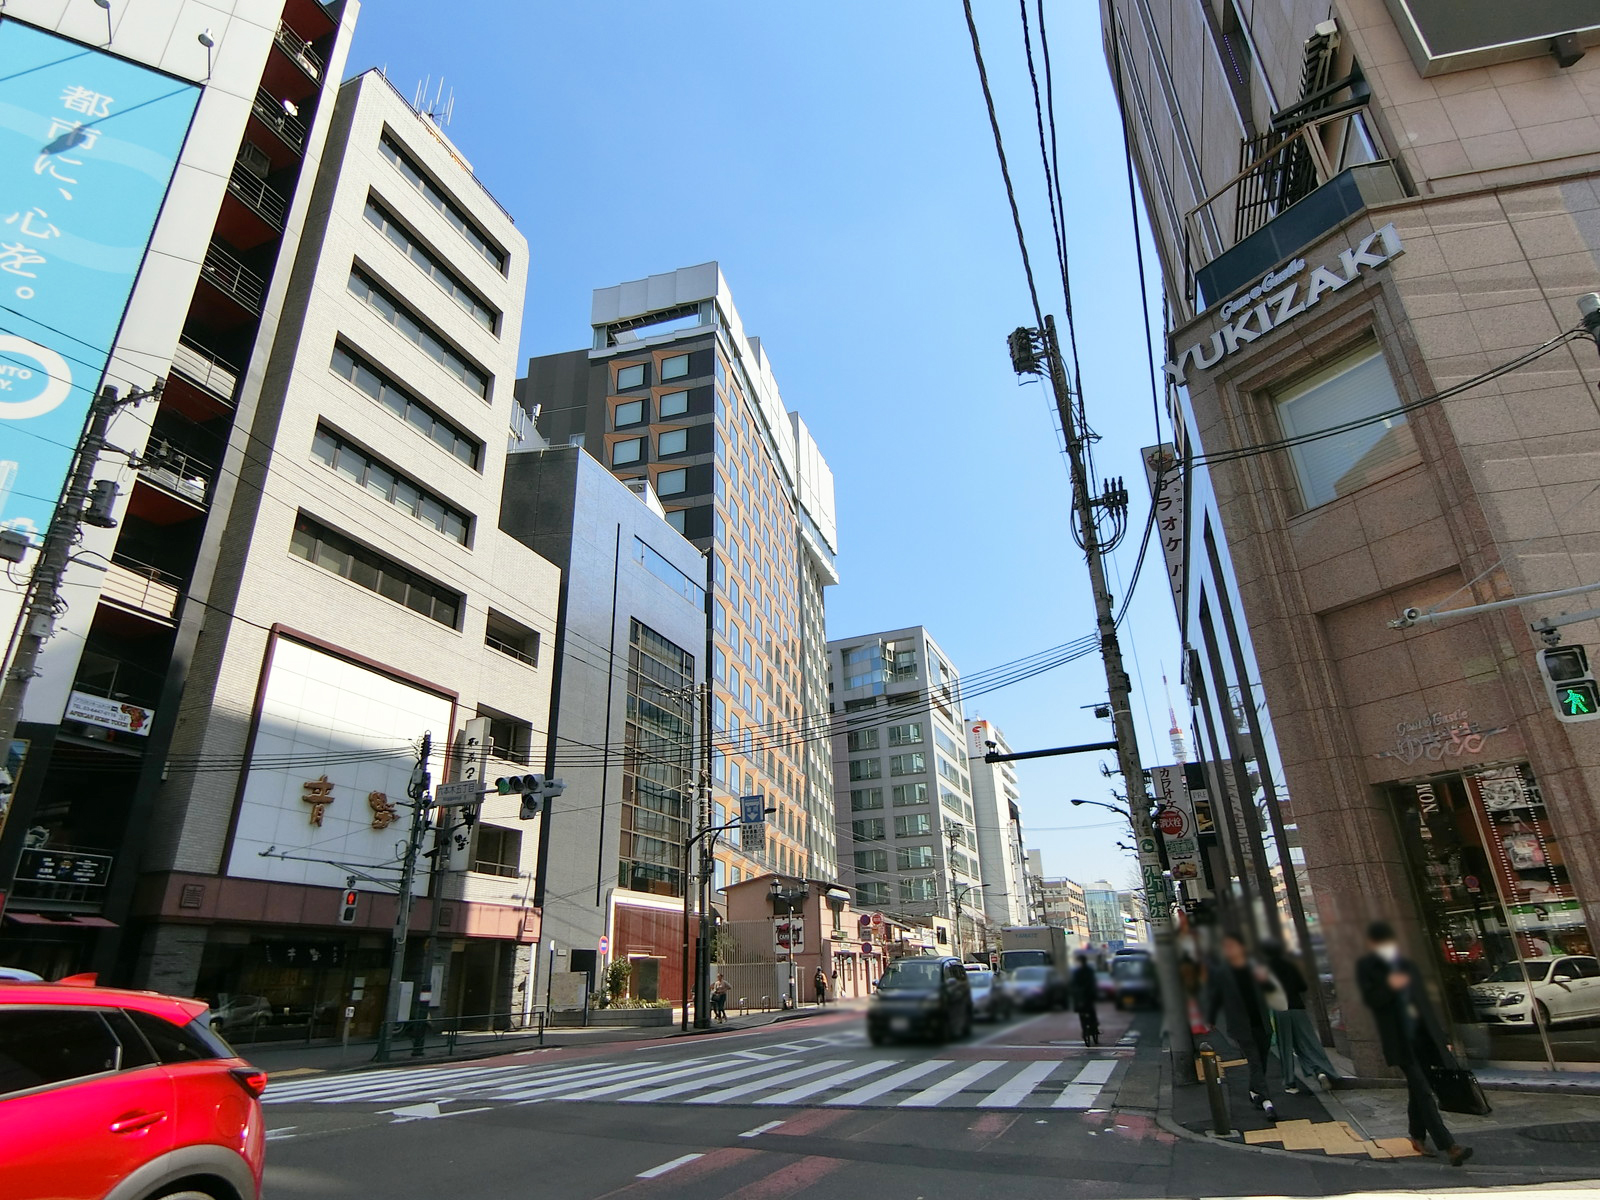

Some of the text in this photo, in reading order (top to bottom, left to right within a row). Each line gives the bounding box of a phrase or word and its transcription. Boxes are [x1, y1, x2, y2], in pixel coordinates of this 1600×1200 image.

[1161, 222, 1405, 387] YUKIZAKI
[437, 783, 475, 796] 六本木五丁目
[1143, 866, 1161, 918] クリニック
